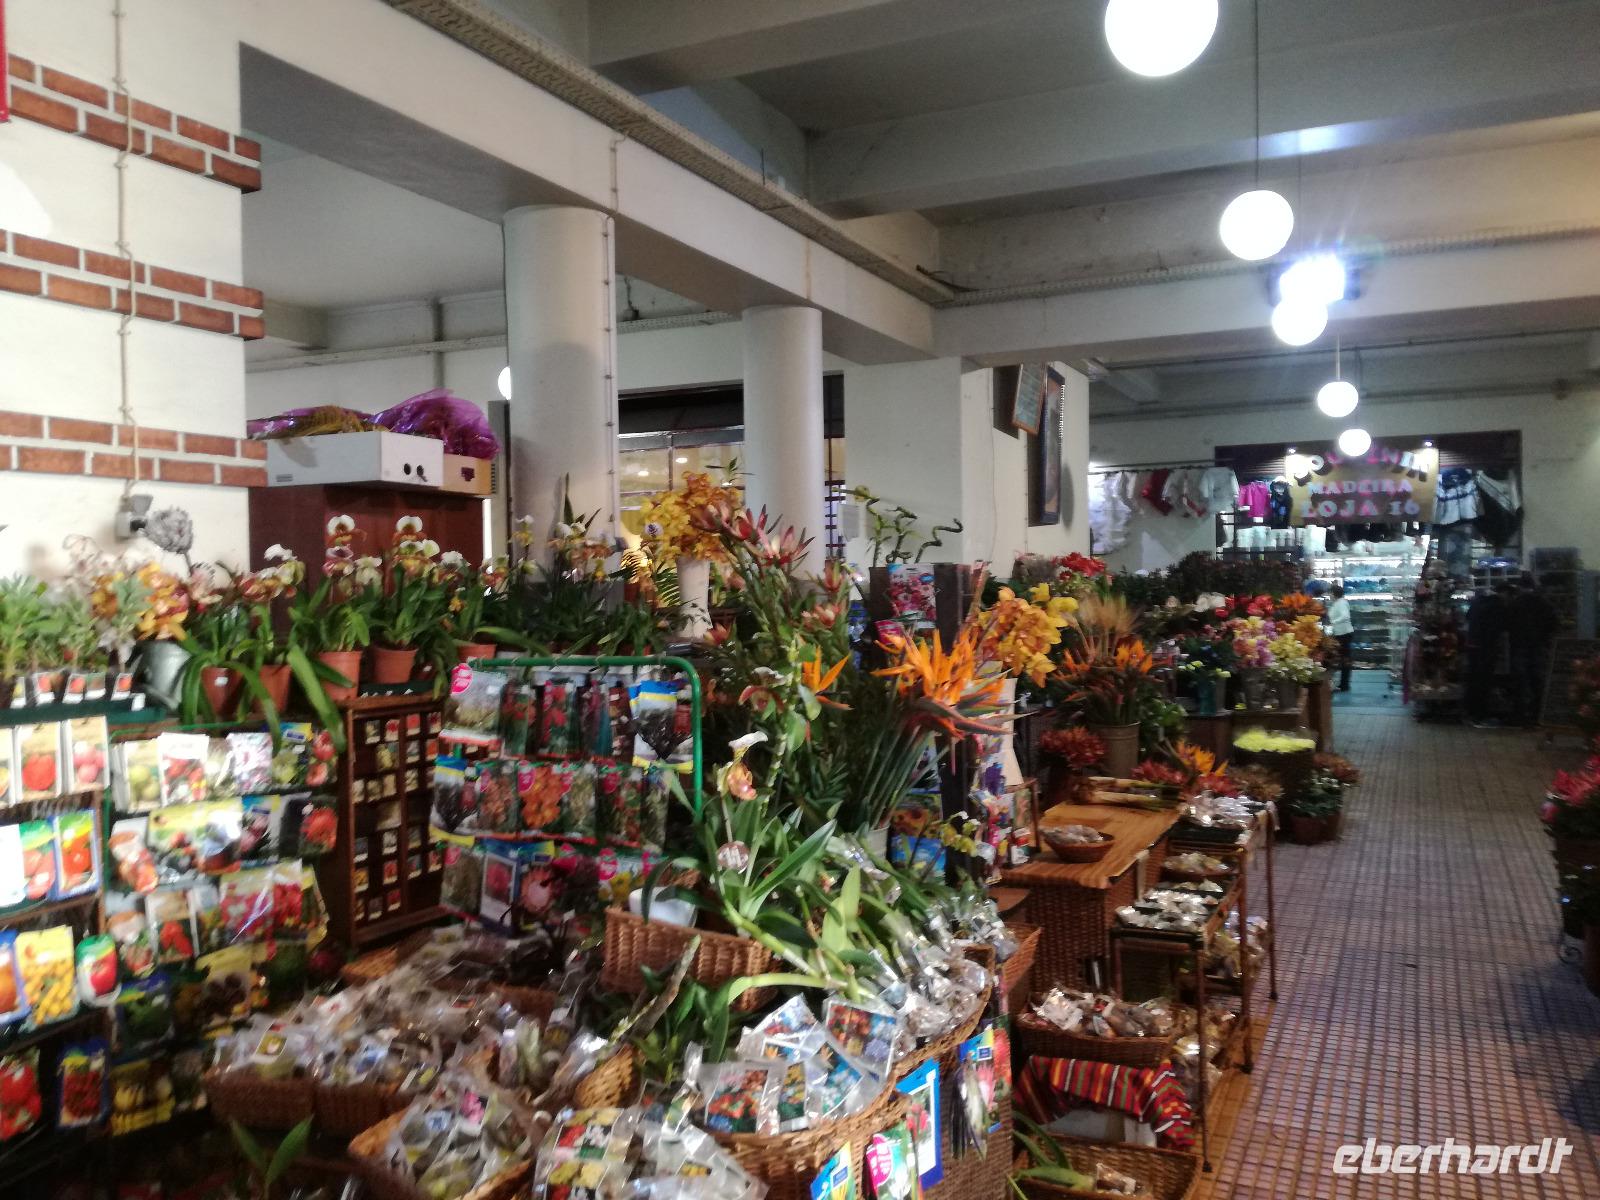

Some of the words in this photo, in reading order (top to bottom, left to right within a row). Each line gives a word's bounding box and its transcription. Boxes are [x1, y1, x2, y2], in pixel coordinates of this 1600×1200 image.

[1307, 479, 1413, 495] MADEIRA
[1302, 499, 1378, 518] LOJA
[1389, 500, 1420, 516] 16
